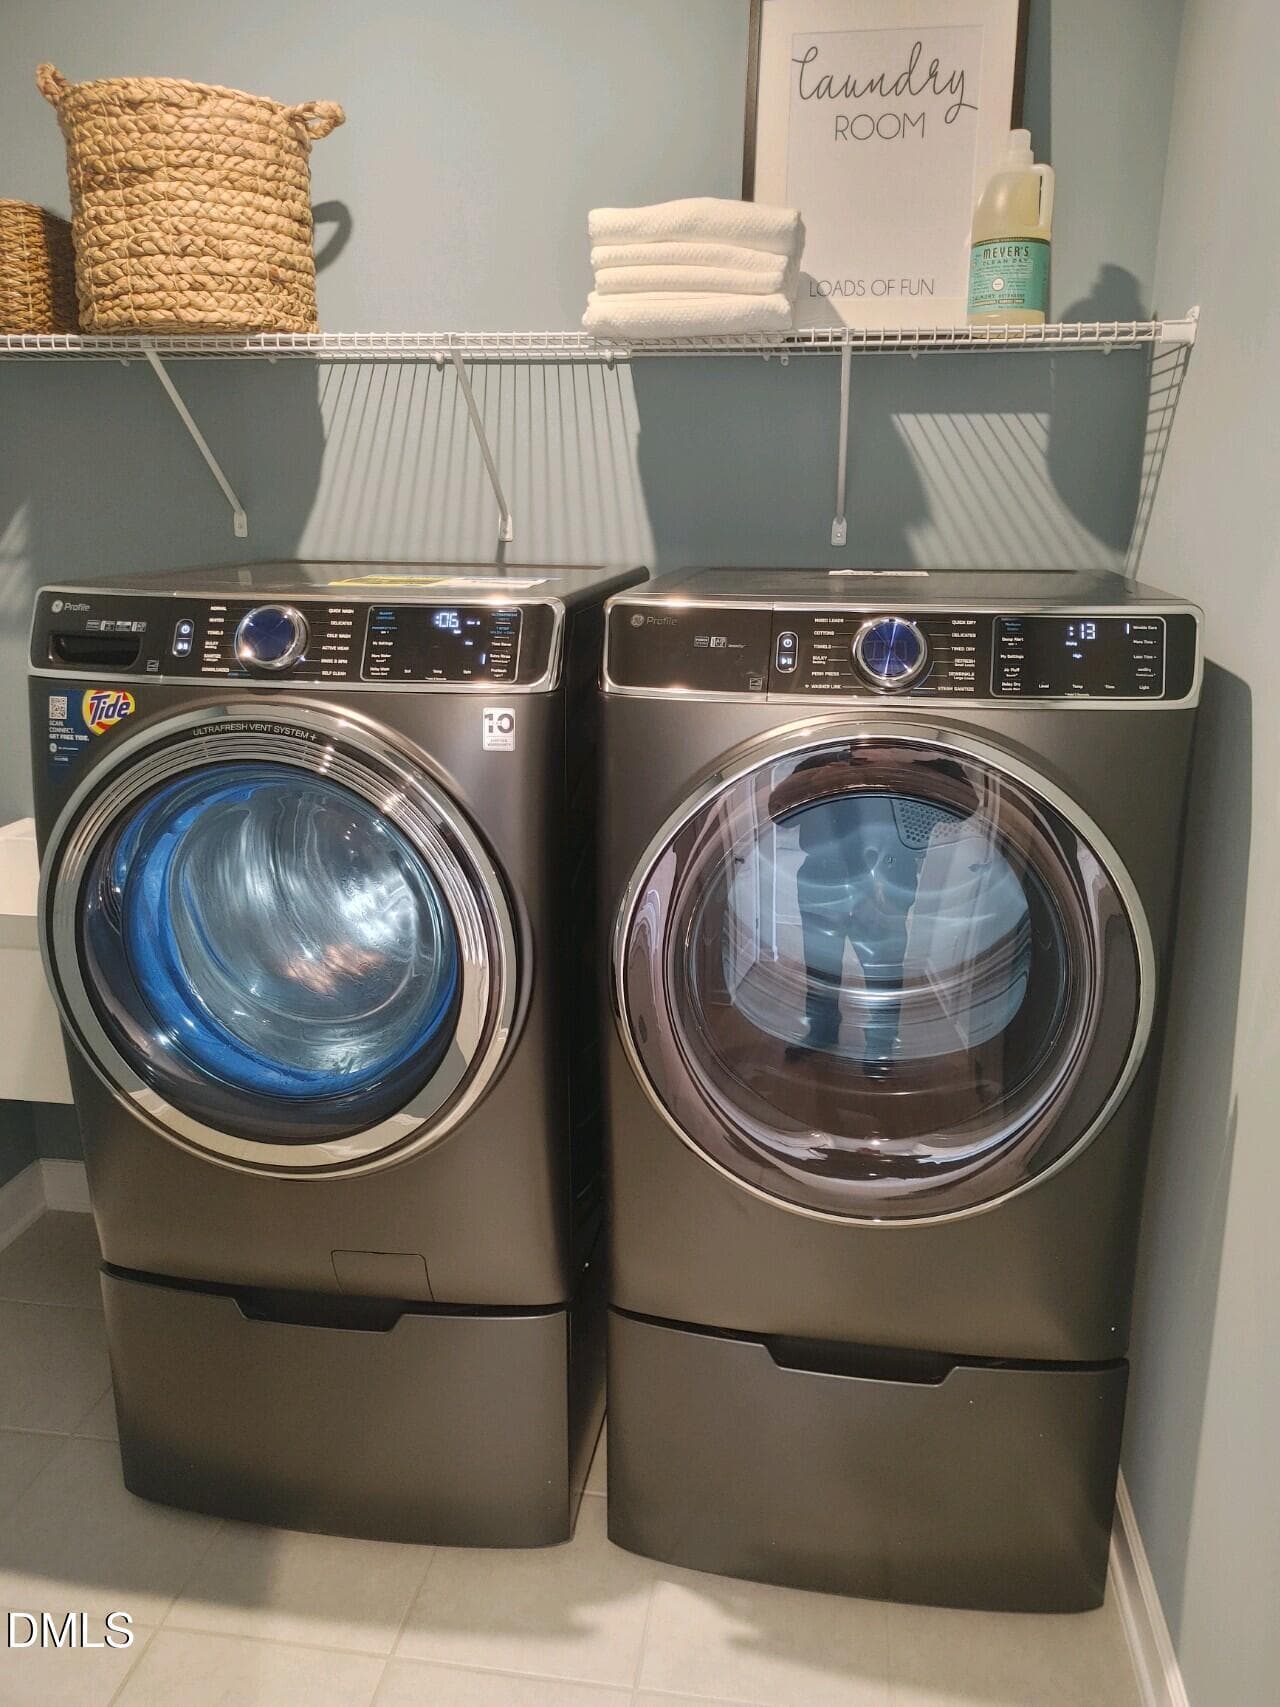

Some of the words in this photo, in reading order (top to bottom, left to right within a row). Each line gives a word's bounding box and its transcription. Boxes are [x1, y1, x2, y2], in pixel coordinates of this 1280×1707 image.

[791, 40, 979, 125] Laundry
[834, 111, 926, 141] ROOM
[983, 246, 1030, 260] MEYER'S
[809, 279, 866, 297] LOADS
[871, 279, 895, 296] OF
[900, 278, 935, 296] FUN
[64, 602, 91, 612] Profile
[646, 615, 678, 626] Profile
[89, 693, 132, 726] Tide
[192, 723, 248, 736] ULTRAFRESH
[248, 723, 272, 732] VENT
[272, 724, 309, 740] SYSTEM
[484, 713, 515, 734] 10
